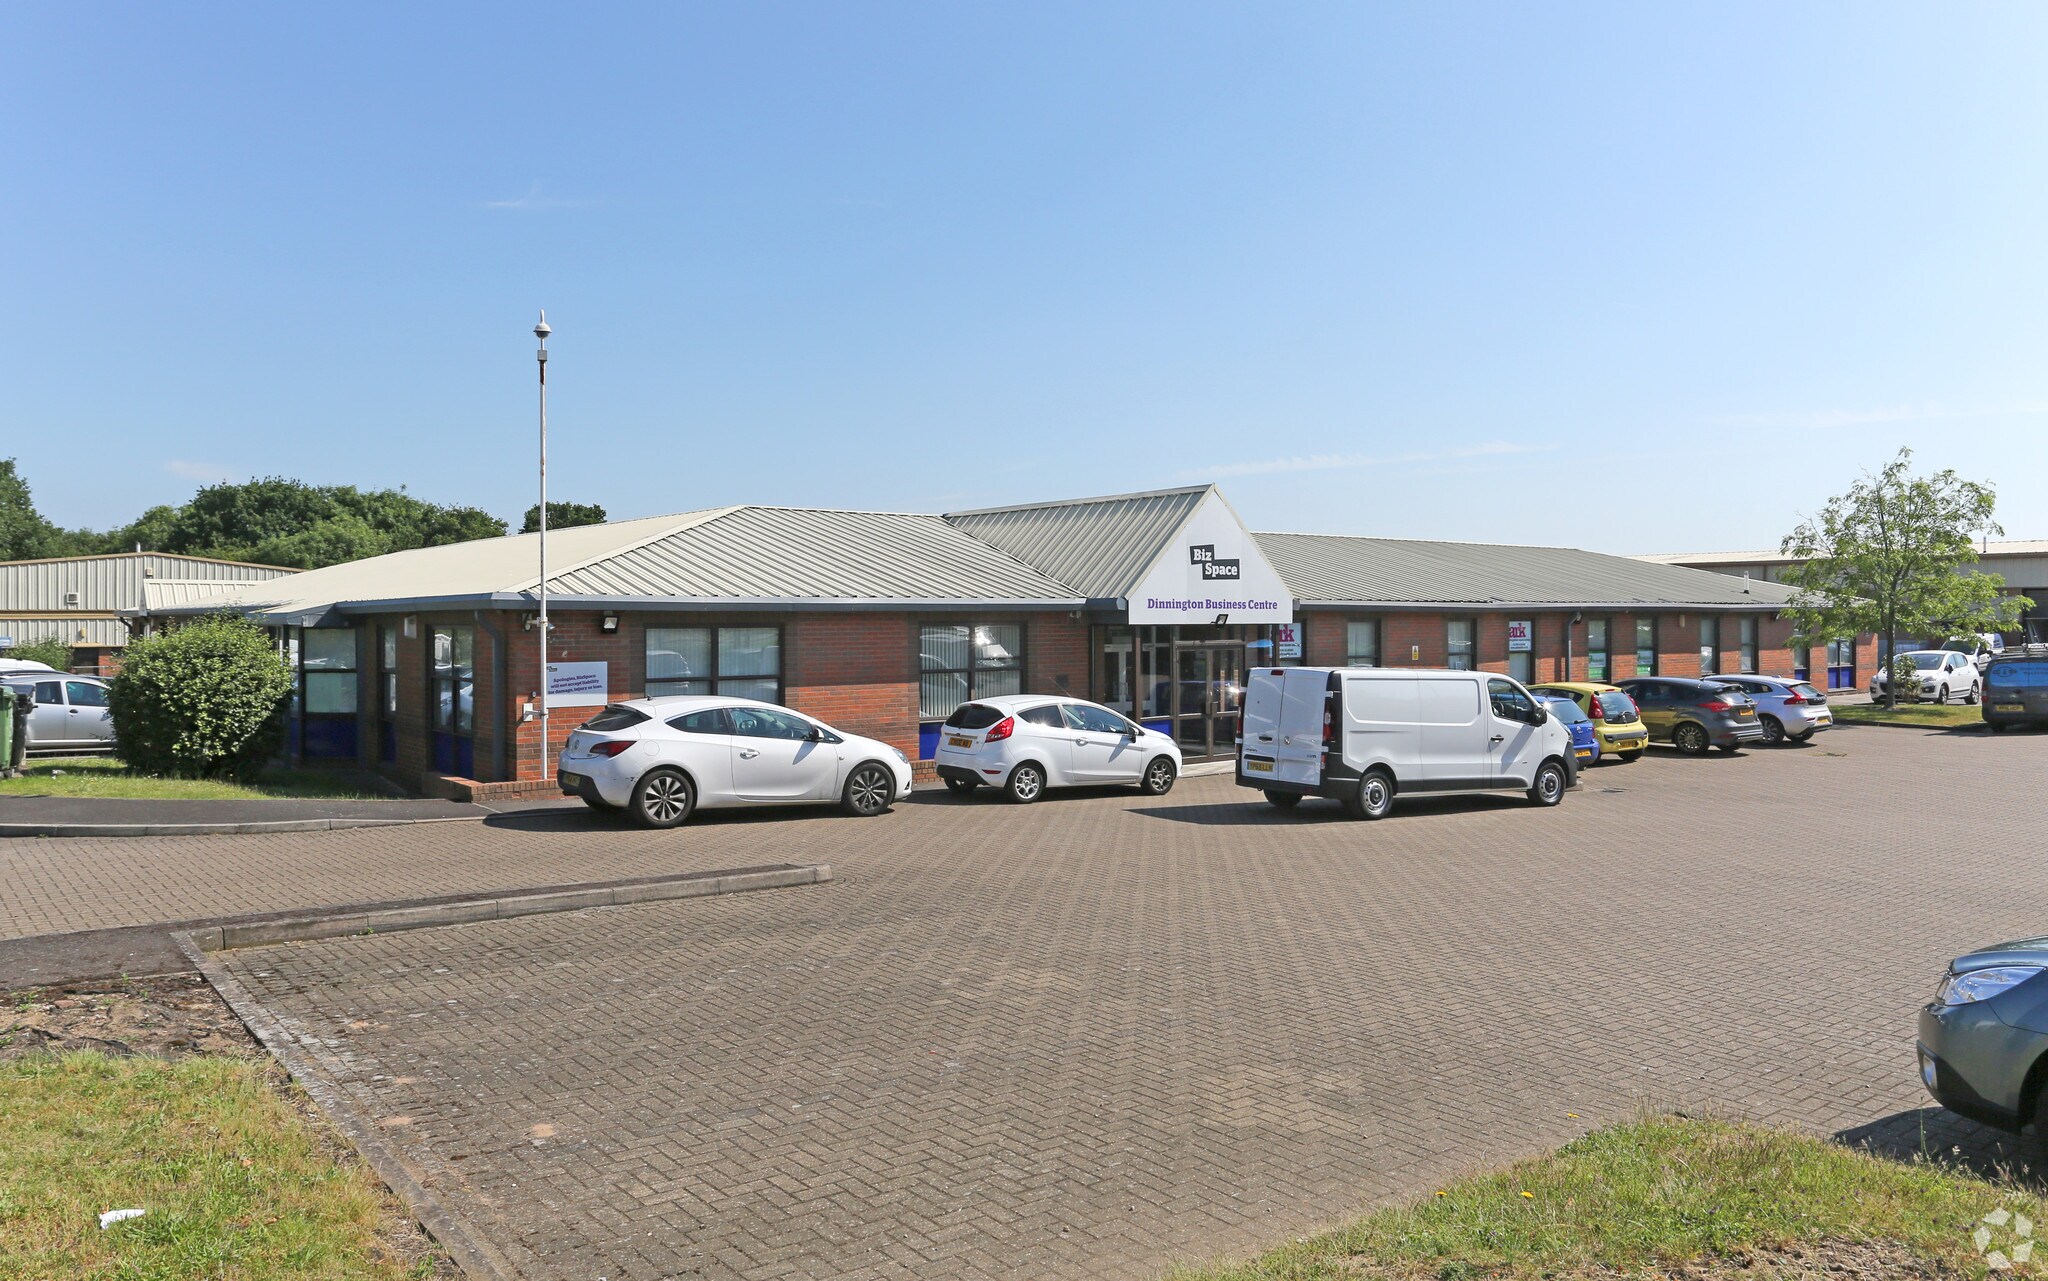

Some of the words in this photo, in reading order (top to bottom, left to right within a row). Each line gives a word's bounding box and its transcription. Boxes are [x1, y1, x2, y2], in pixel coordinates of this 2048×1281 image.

[1193, 549, 1212, 561] Biz
[1205, 563, 1238, 577] Space
[1147, 598, 1204, 611] Dinnington
[1205, 599, 1247, 610] Business
[1248, 600, 1278, 610] Centre
